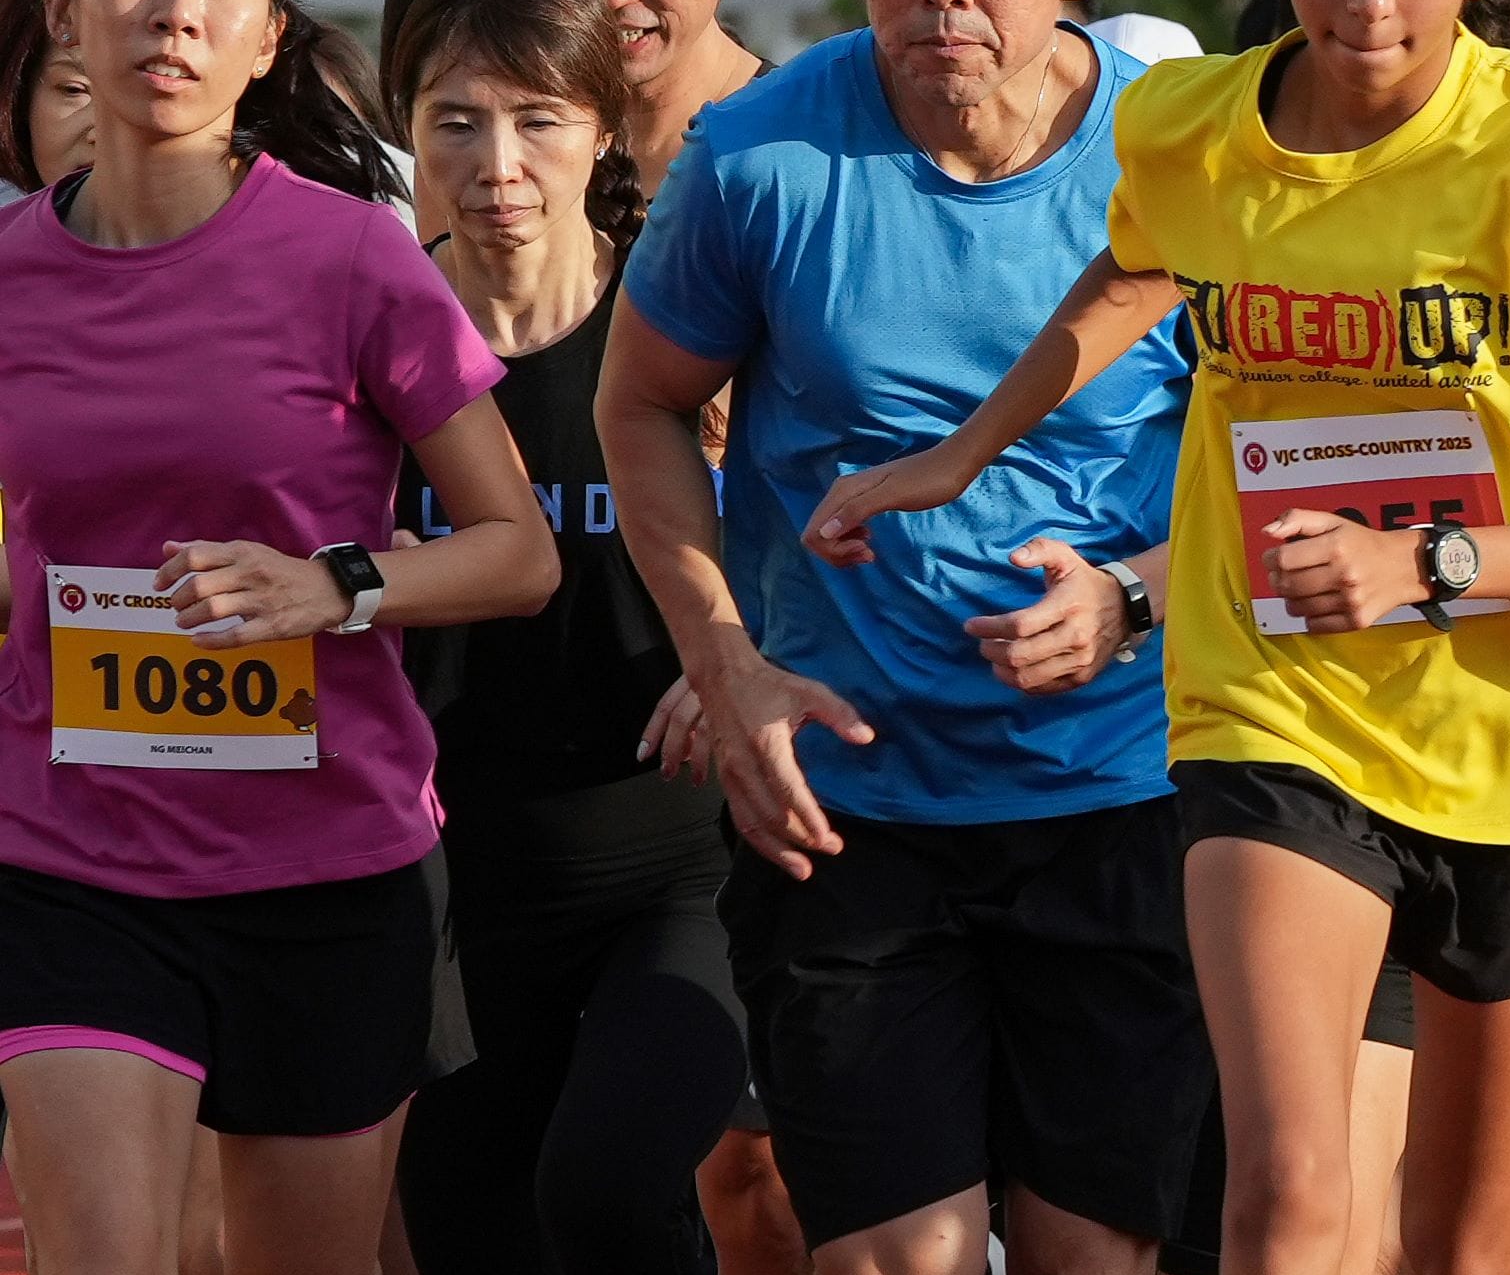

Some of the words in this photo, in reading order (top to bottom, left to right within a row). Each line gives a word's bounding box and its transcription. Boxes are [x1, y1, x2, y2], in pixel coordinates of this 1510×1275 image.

[1239, 367, 1295, 384] junior
[1373, 372, 1433, 388] united
[1272, 448, 1299, 467] VJC
[1303, 438, 1433, 461] CROSS-COUNTRY
[1437, 436, 1472, 452] 2025
[92, 593, 119, 610] VJC
[123, 594, 171, 610] CROSS
[91, 653, 277, 717] 1080
[150, 745, 165, 754] NG
